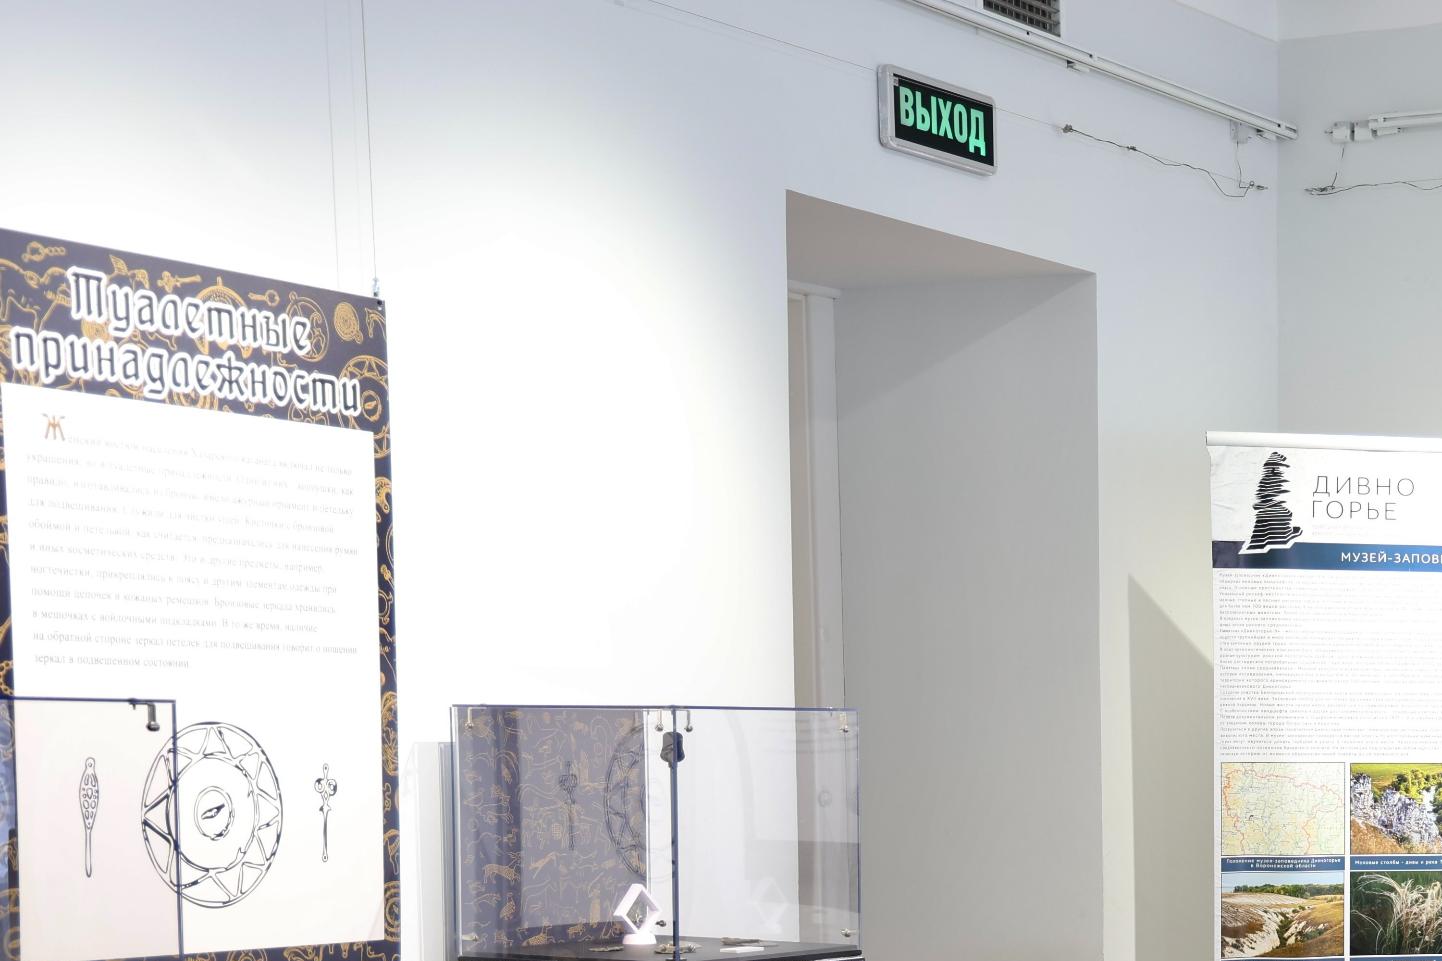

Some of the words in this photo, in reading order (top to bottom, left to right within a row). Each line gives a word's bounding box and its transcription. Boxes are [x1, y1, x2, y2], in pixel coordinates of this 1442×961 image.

[900, 86, 986, 157] ВЫХОД
[69, 268, 311, 354] Туалетные
[12, 328, 362, 414] принадлежности
[1313, 476, 1414, 496] ДИВНО
[1313, 500, 1396, 520] ГОРЬЕ
